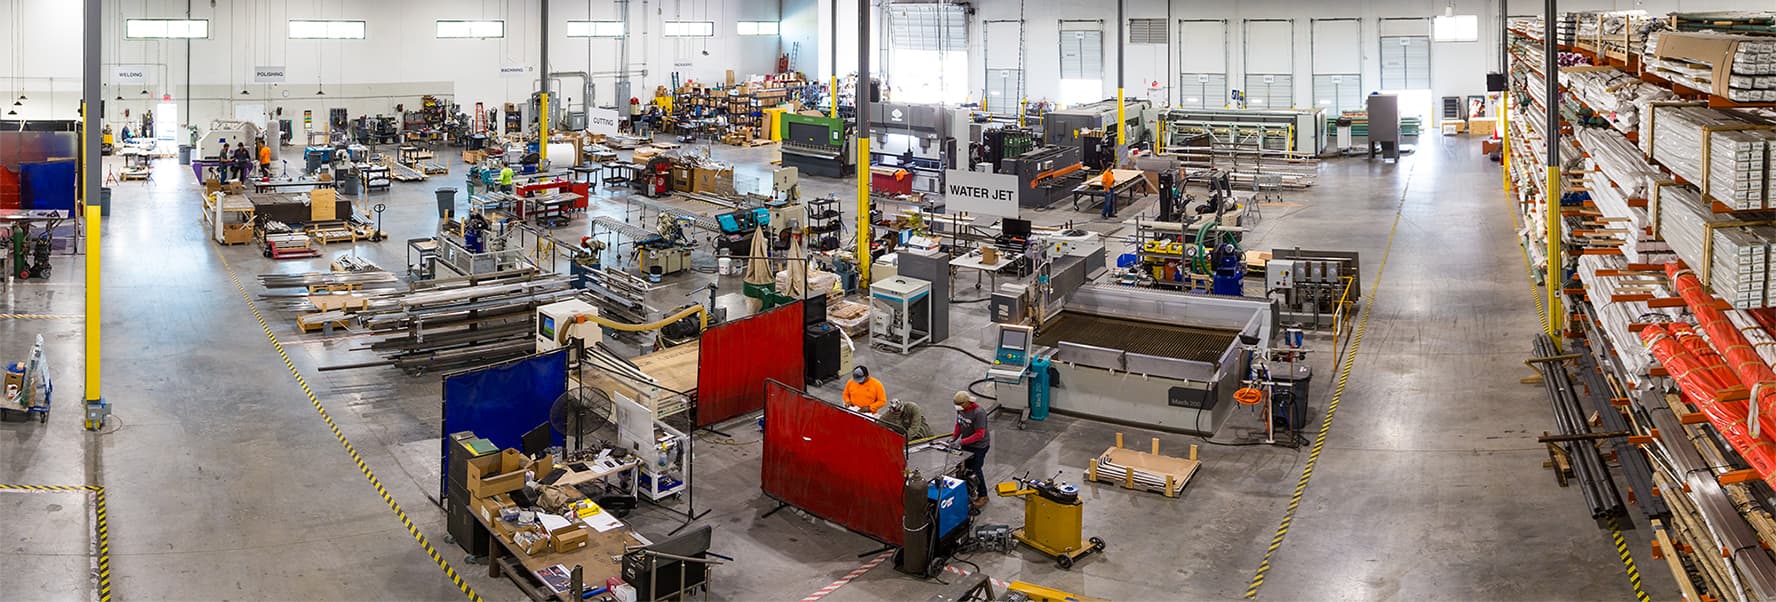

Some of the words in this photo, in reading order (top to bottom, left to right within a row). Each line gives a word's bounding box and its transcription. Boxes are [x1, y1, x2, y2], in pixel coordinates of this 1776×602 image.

[592, 116, 614, 127] CUTTING
[949, 184, 989, 199] WATER
[992, 188, 1014, 201] JET
